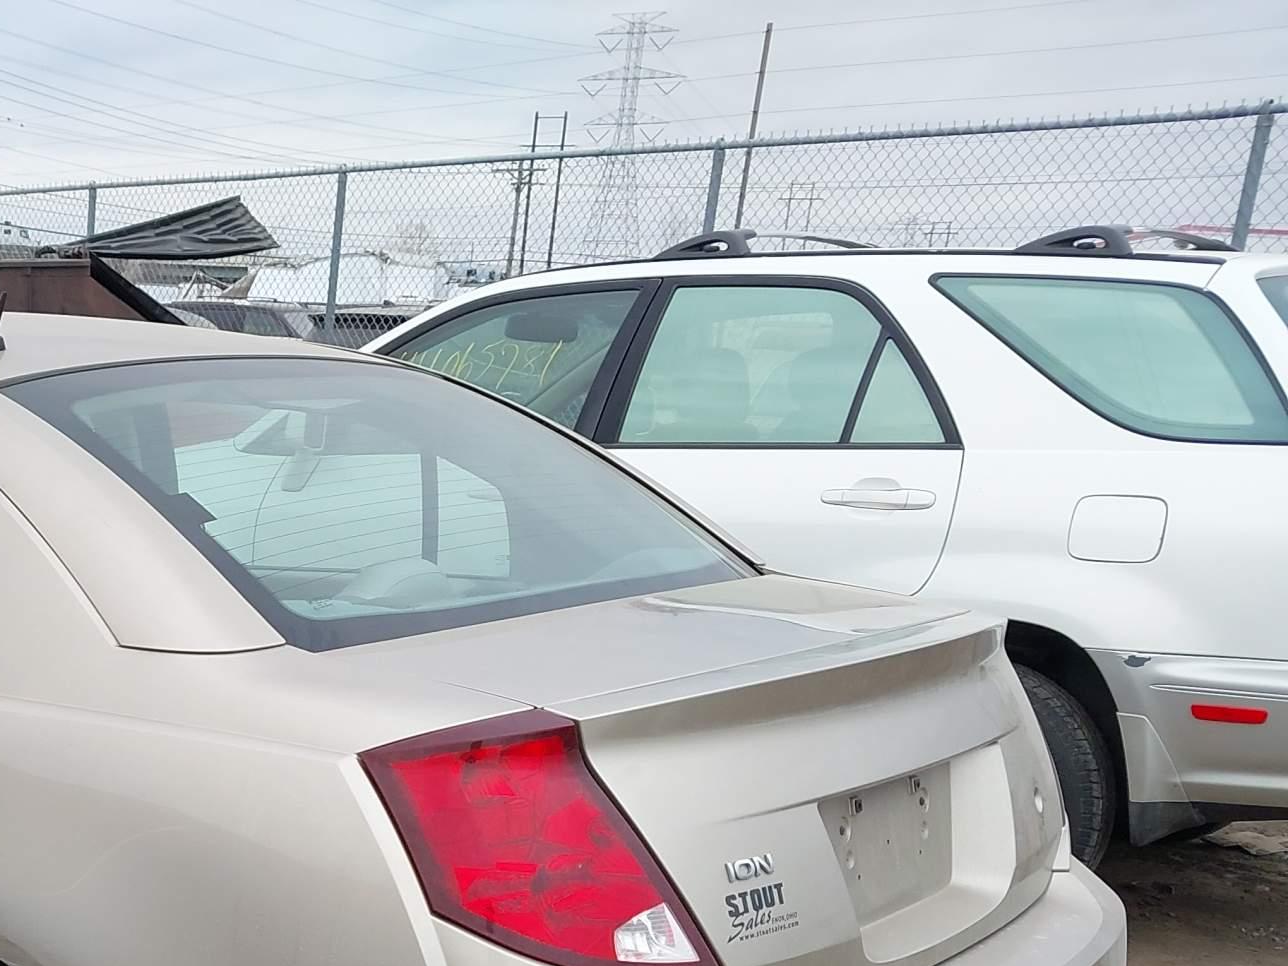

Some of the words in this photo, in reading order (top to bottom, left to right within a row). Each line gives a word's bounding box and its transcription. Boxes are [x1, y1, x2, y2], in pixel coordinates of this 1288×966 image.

[724, 853, 775, 884] ION
[725, 882, 785, 918] STOUT
[727, 910, 773, 944] Sales
